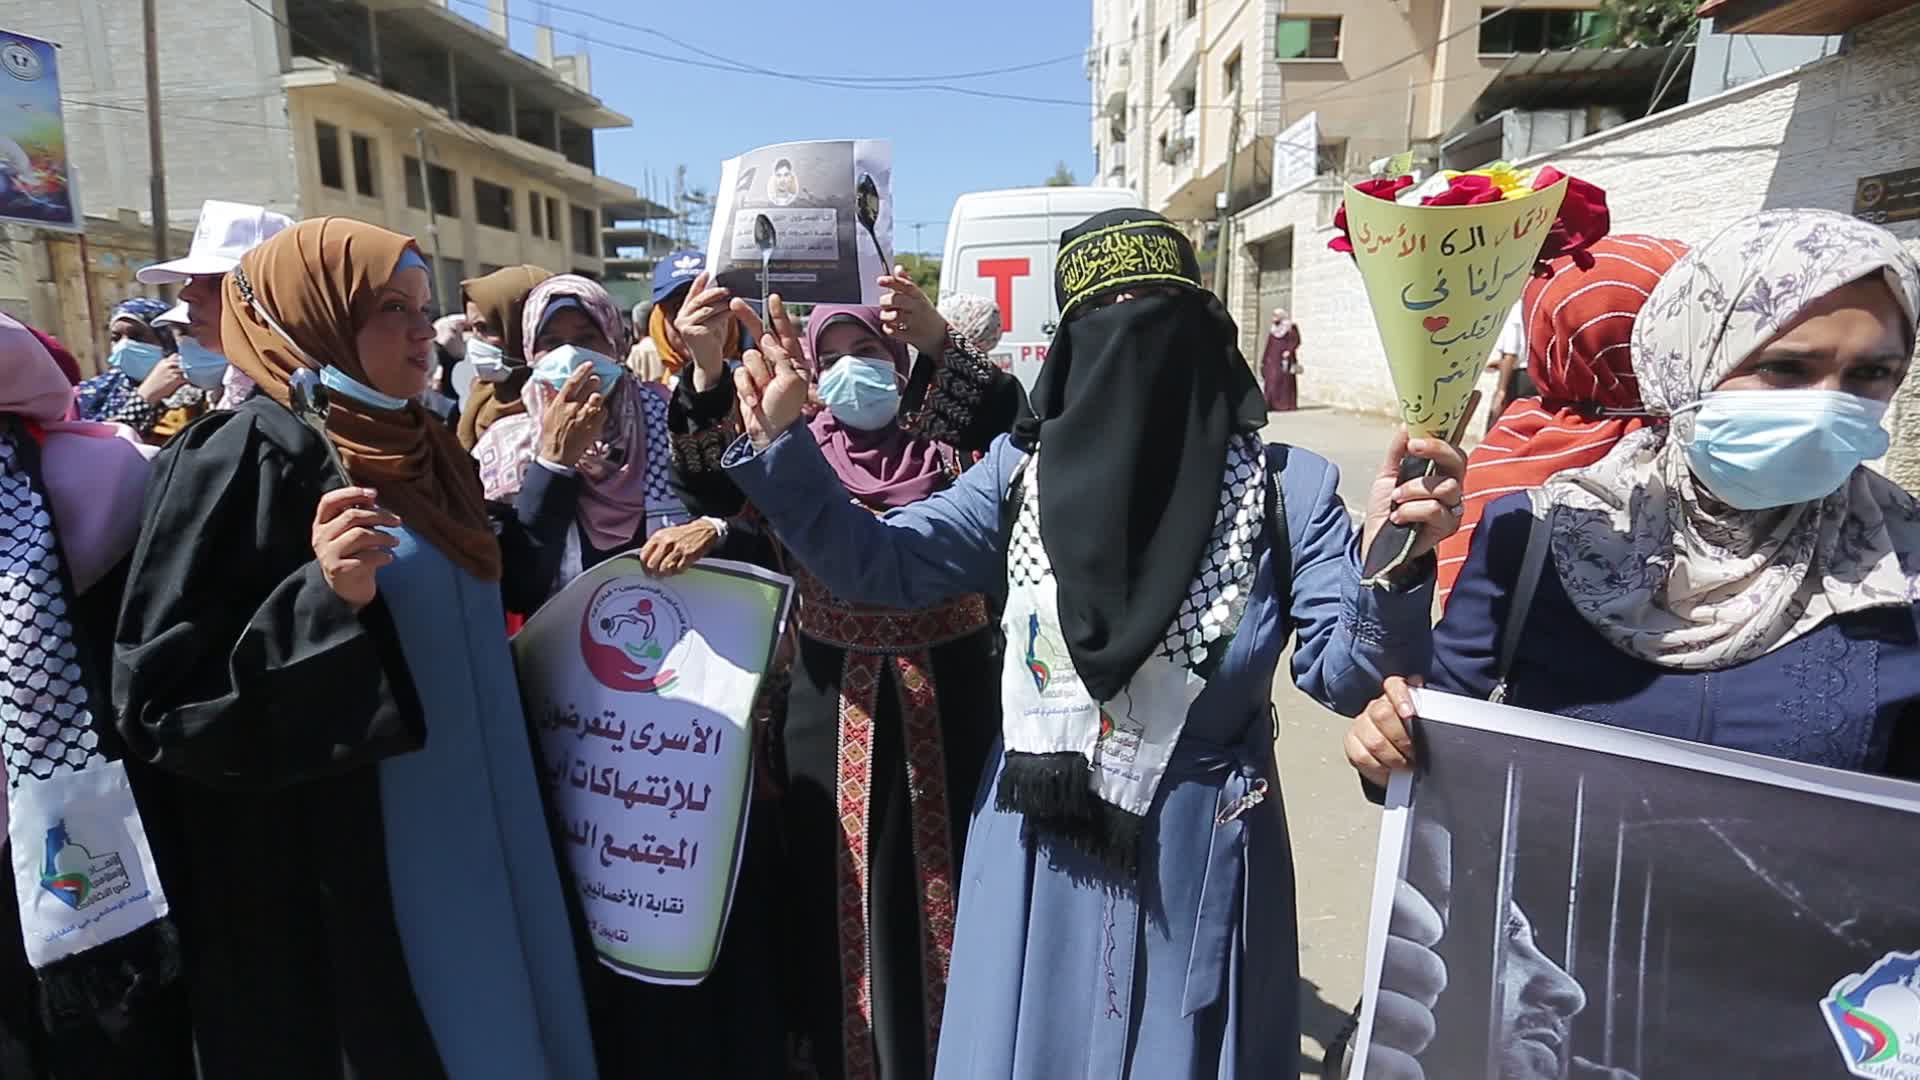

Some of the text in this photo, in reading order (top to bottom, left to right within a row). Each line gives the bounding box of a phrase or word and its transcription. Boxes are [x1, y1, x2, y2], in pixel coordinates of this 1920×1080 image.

[629, 718, 722, 756] الأسرى
[600, 833, 698, 875] المجتمع
[646, 893, 684, 919] نقابة
